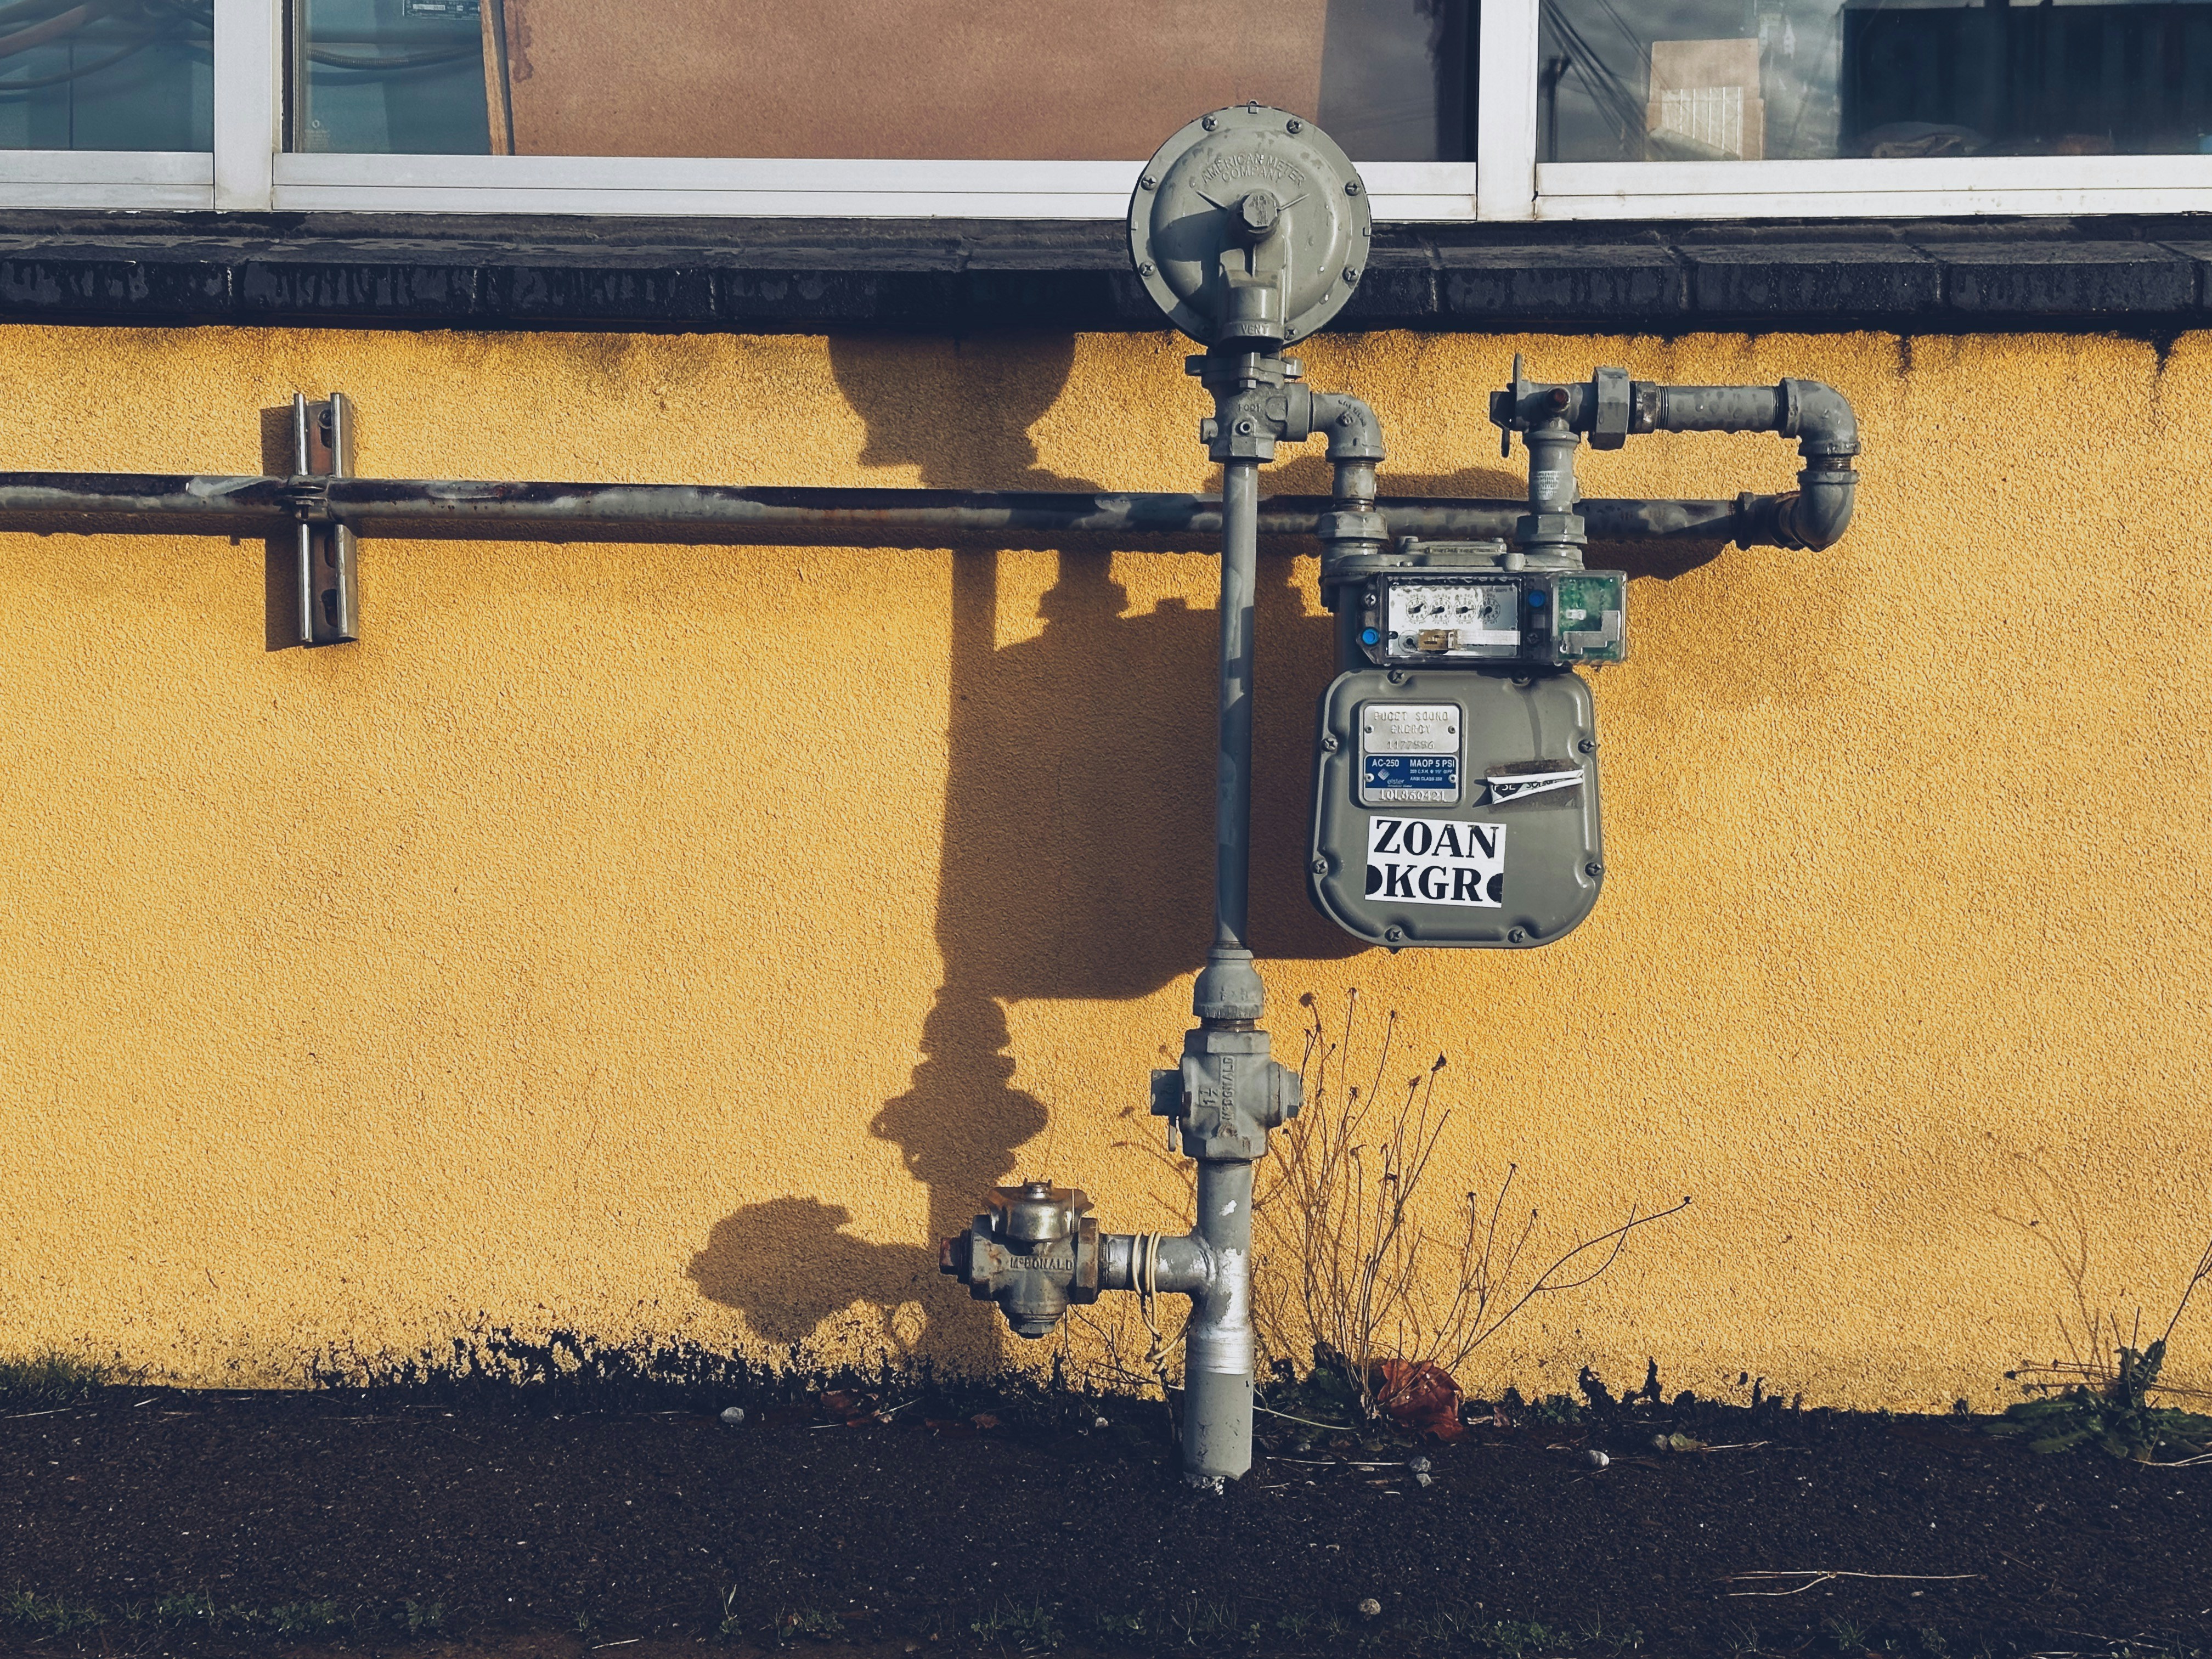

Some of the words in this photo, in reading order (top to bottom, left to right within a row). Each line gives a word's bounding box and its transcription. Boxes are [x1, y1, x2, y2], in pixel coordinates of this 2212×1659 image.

[1201, 153, 1265, 184] AMERICAN
[1267, 154, 1306, 187] METER
[1221, 166, 1281, 183] COMPANY
[1241, 324, 1269, 335] VENT
[1415, 712, 1448, 721] SOUND
[1372, 759, 1400, 768] AC-250
[1409, 759, 1434, 768] MAOP
[1435, 759, 1440, 768] 5
[1442, 759, 1455, 768] PSI
[1374, 819, 1499, 859] ZOAN
[1384, 864, 1483, 902] KGR
[1010, 1257, 1074, 1271] McDONALD
